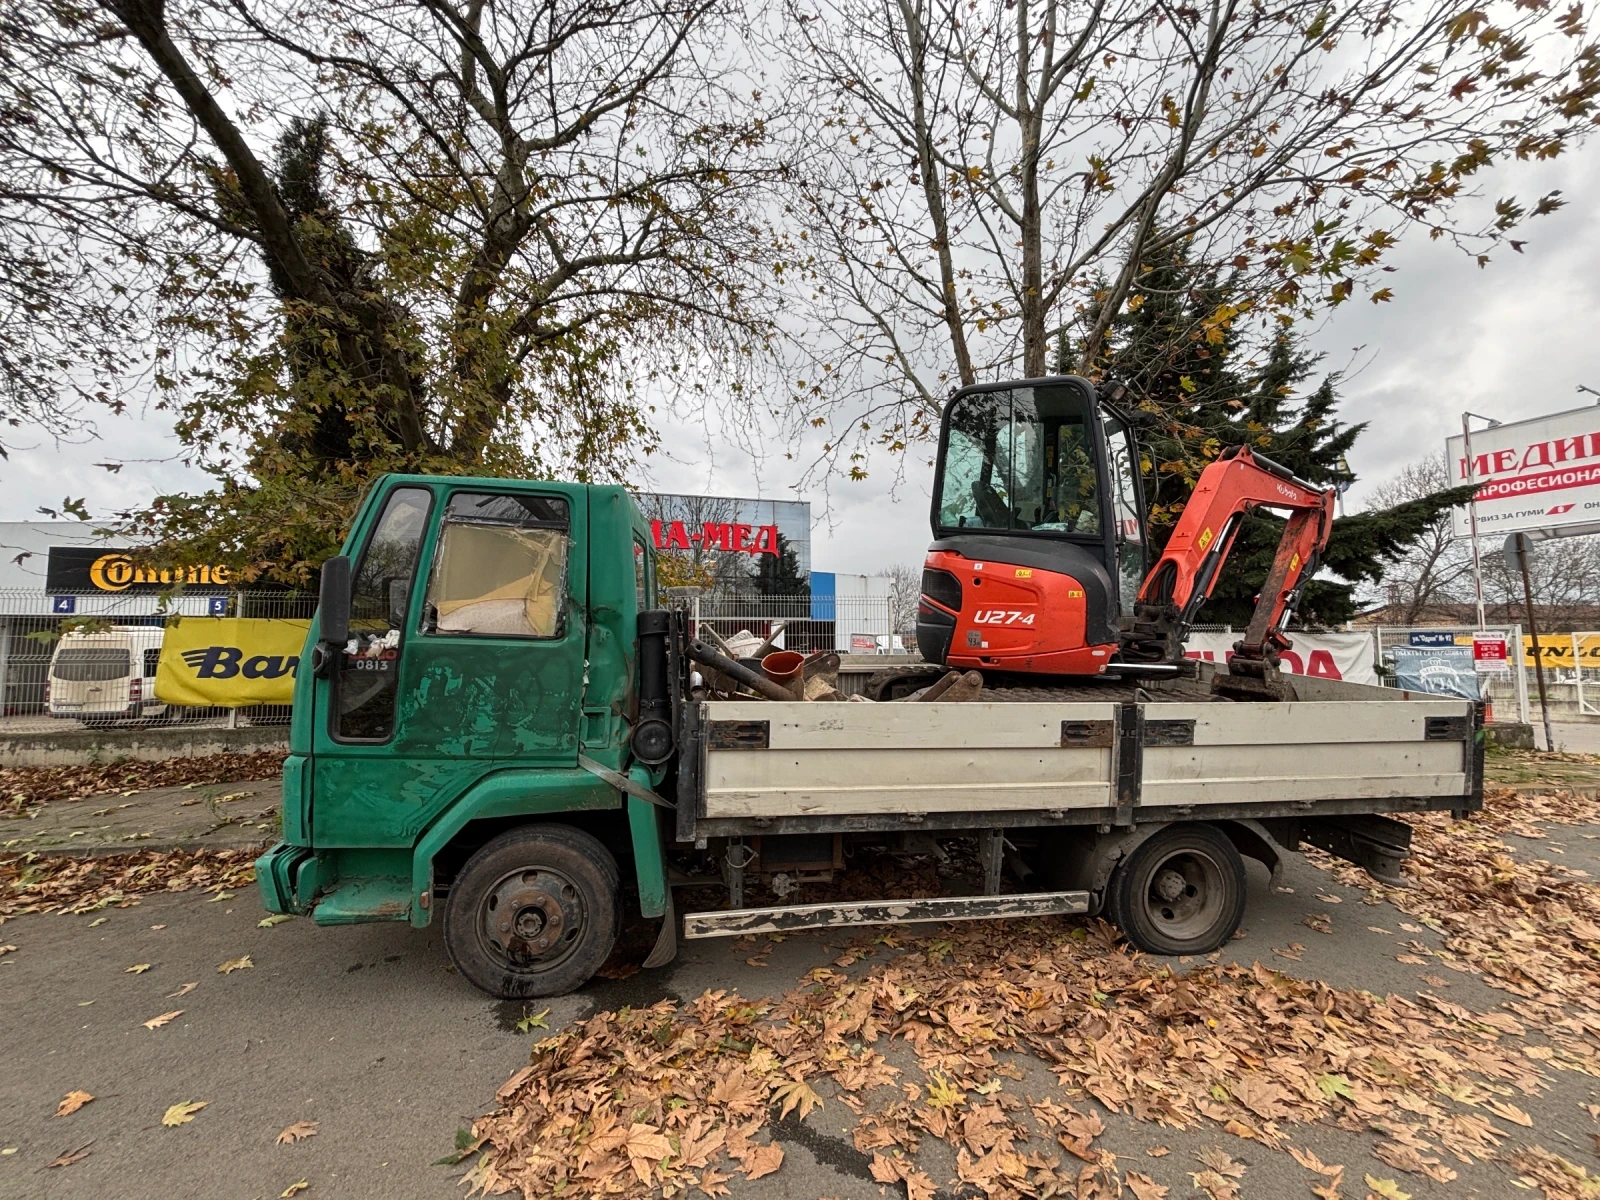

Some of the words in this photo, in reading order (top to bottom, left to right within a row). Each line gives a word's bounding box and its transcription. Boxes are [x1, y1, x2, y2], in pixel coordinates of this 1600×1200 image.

[1584, 501, 1600, 510] ОН
[1464, 514, 1499, 525] СРВИЗ
[1516, 508, 1545, 518] ГУМИ
[59, 599, 69, 610] 4
[214, 601, 222, 611] 5
[973, 610, 1036, 625] U27-4
[356, 660, 388, 670] 0813
